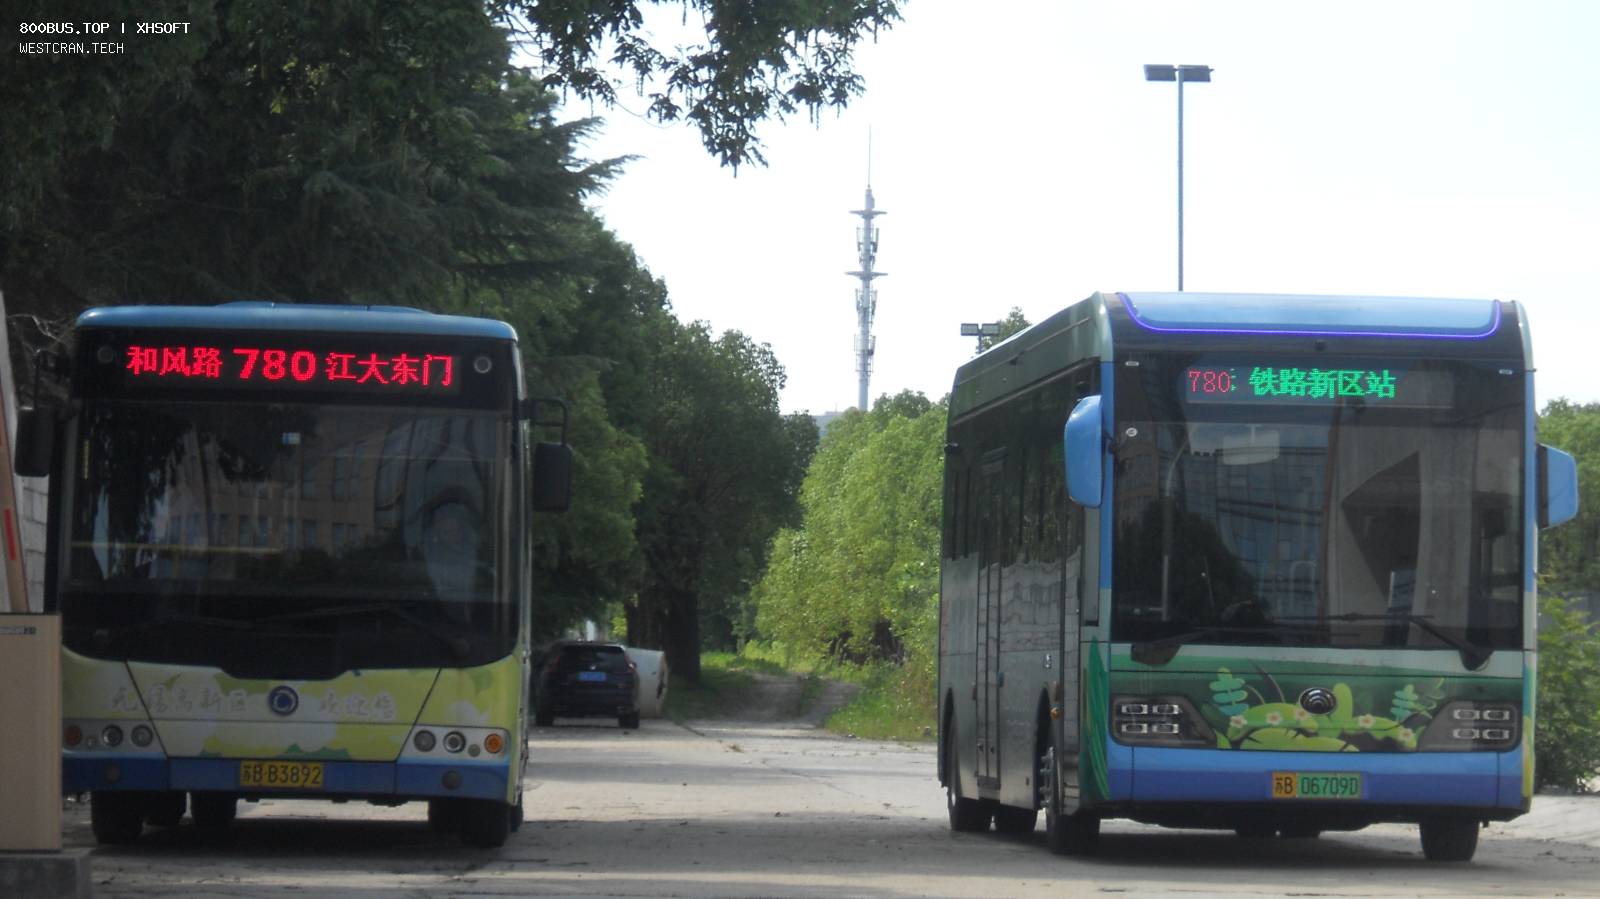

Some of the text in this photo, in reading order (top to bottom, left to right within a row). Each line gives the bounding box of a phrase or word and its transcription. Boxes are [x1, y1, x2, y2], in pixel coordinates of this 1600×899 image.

[126, 345, 453, 387] 和风路 780 江大东门
[1189, 366, 1397, 400] 780 铁路新区站
